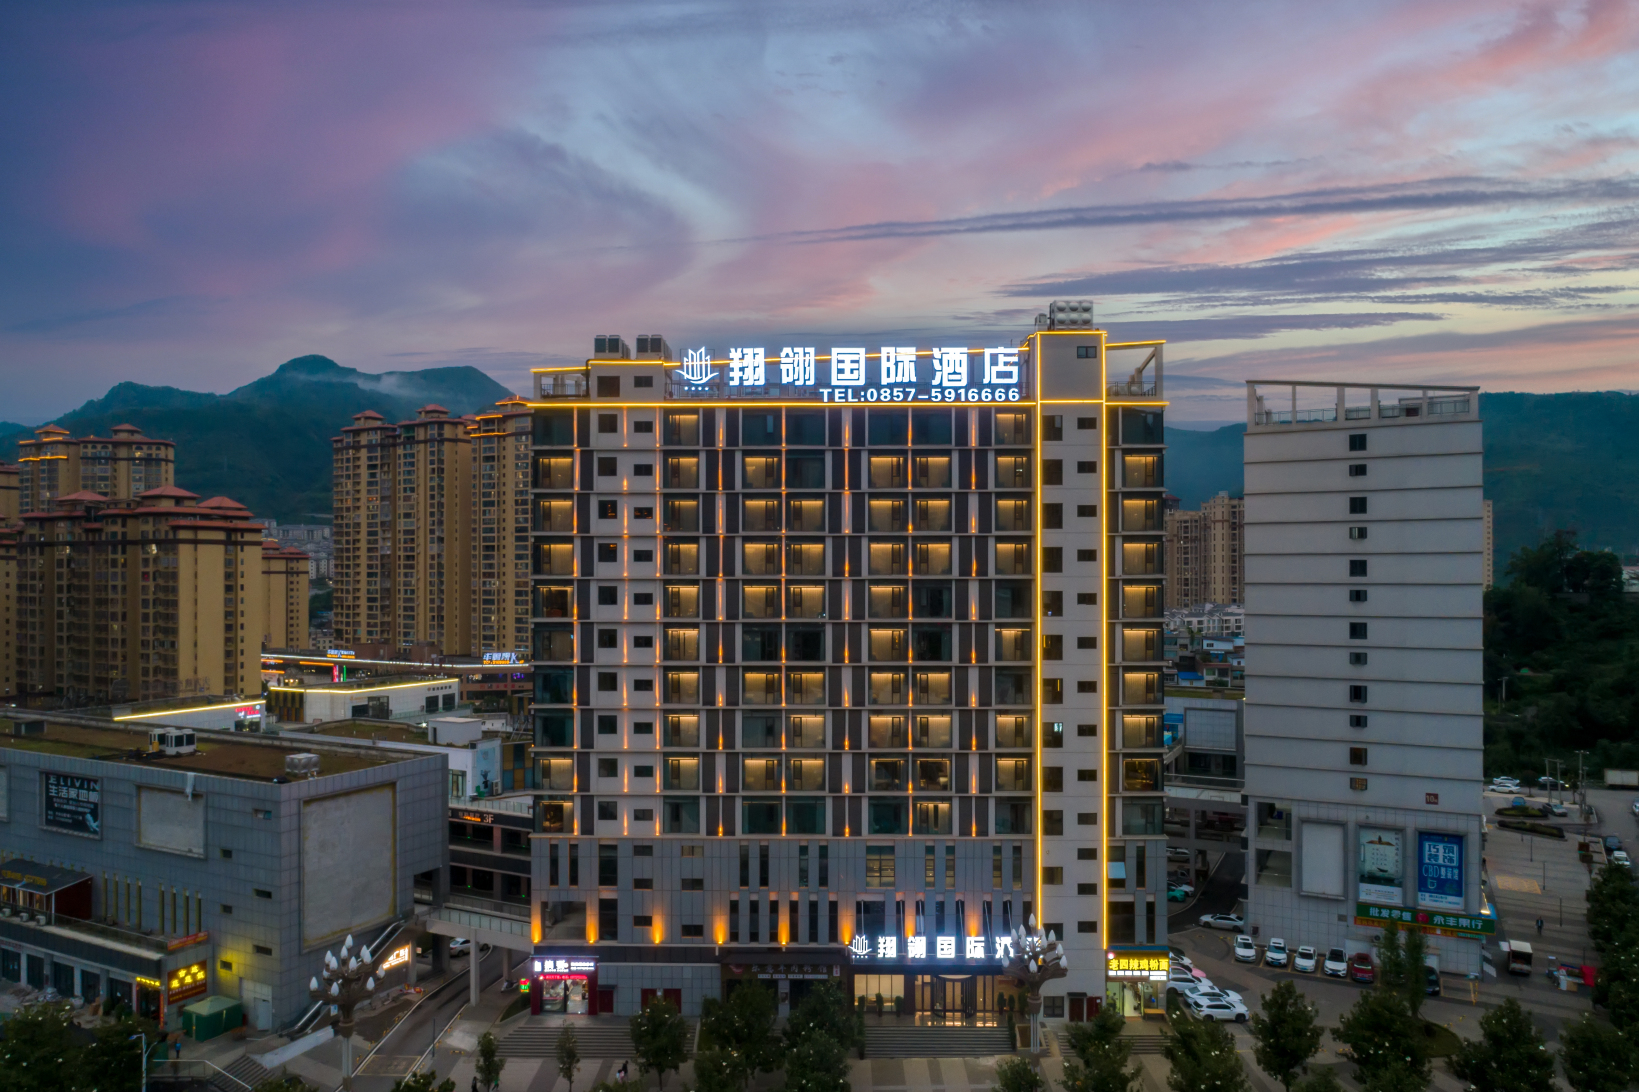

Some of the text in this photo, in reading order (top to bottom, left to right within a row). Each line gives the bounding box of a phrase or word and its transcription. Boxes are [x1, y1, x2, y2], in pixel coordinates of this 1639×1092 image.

[728, 346, 1020, 387] 翔翎国际酒店
[819, 387, 1021, 403] TEL:0857-5916666
[877, 936, 1043, 959] 翔翎国际酒
[1109, 958, 1168, 970] 老四辣鸡粉面
